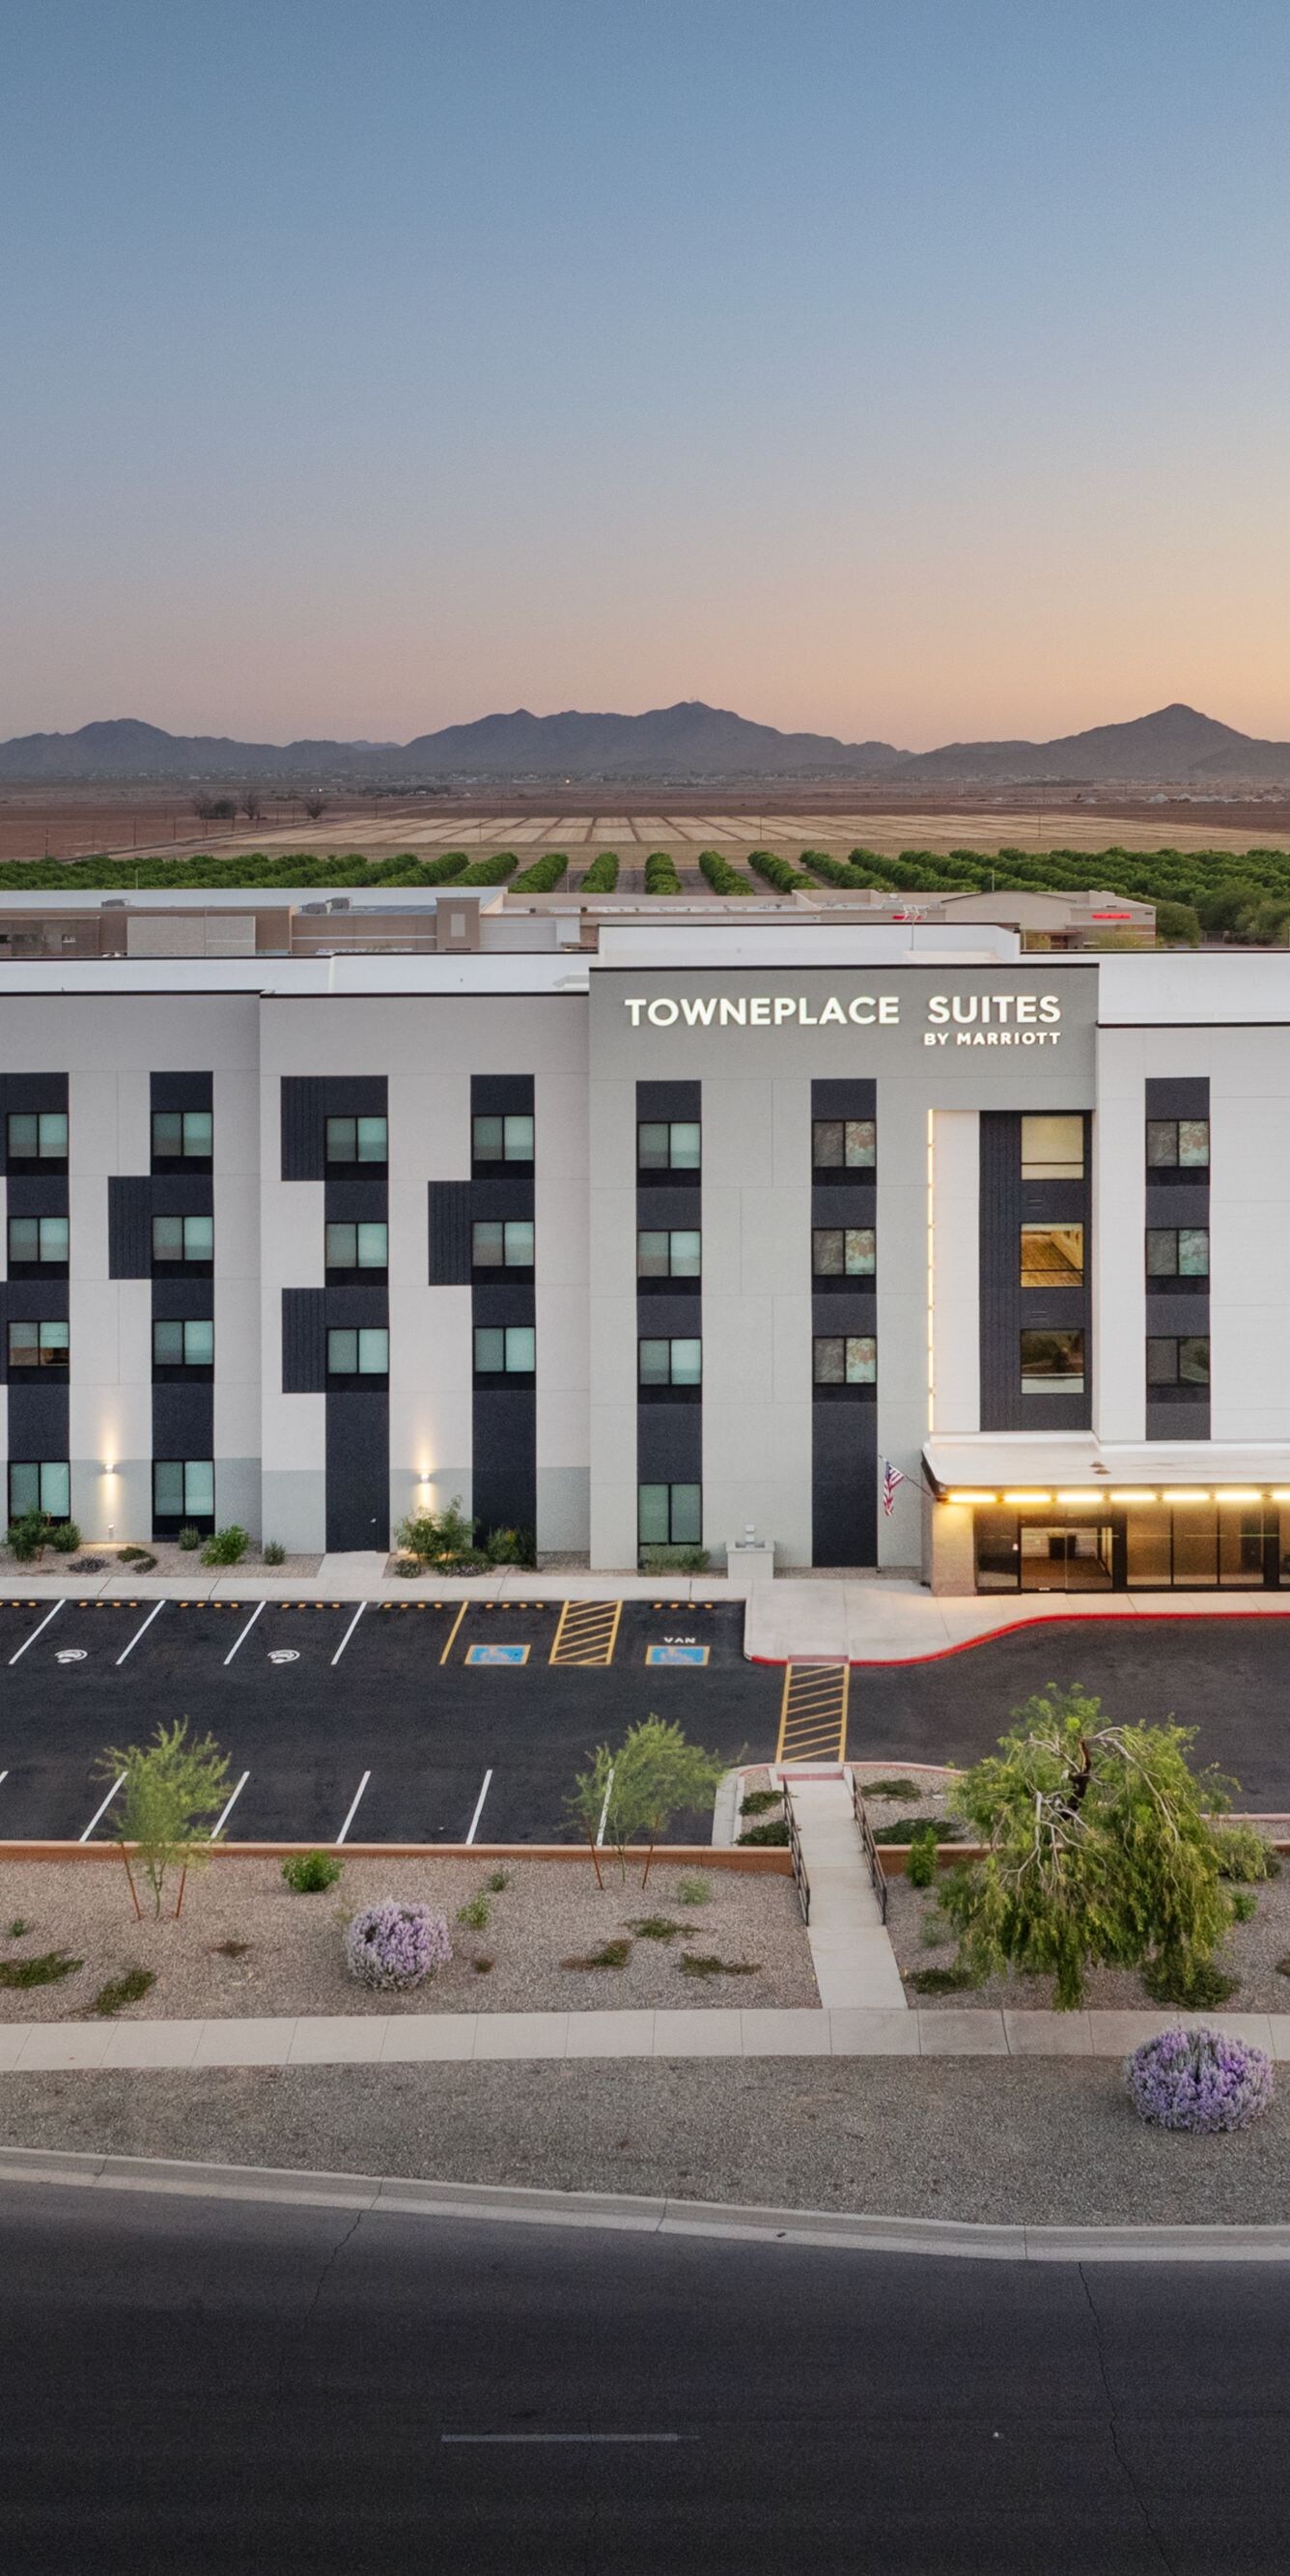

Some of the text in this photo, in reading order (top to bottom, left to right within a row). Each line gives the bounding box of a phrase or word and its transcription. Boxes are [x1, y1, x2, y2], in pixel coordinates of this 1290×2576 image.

[625, 995, 1061, 1027] TOWNEPLACE SUITES
[924, 1032, 1061, 1046] BY MARRIOTT
